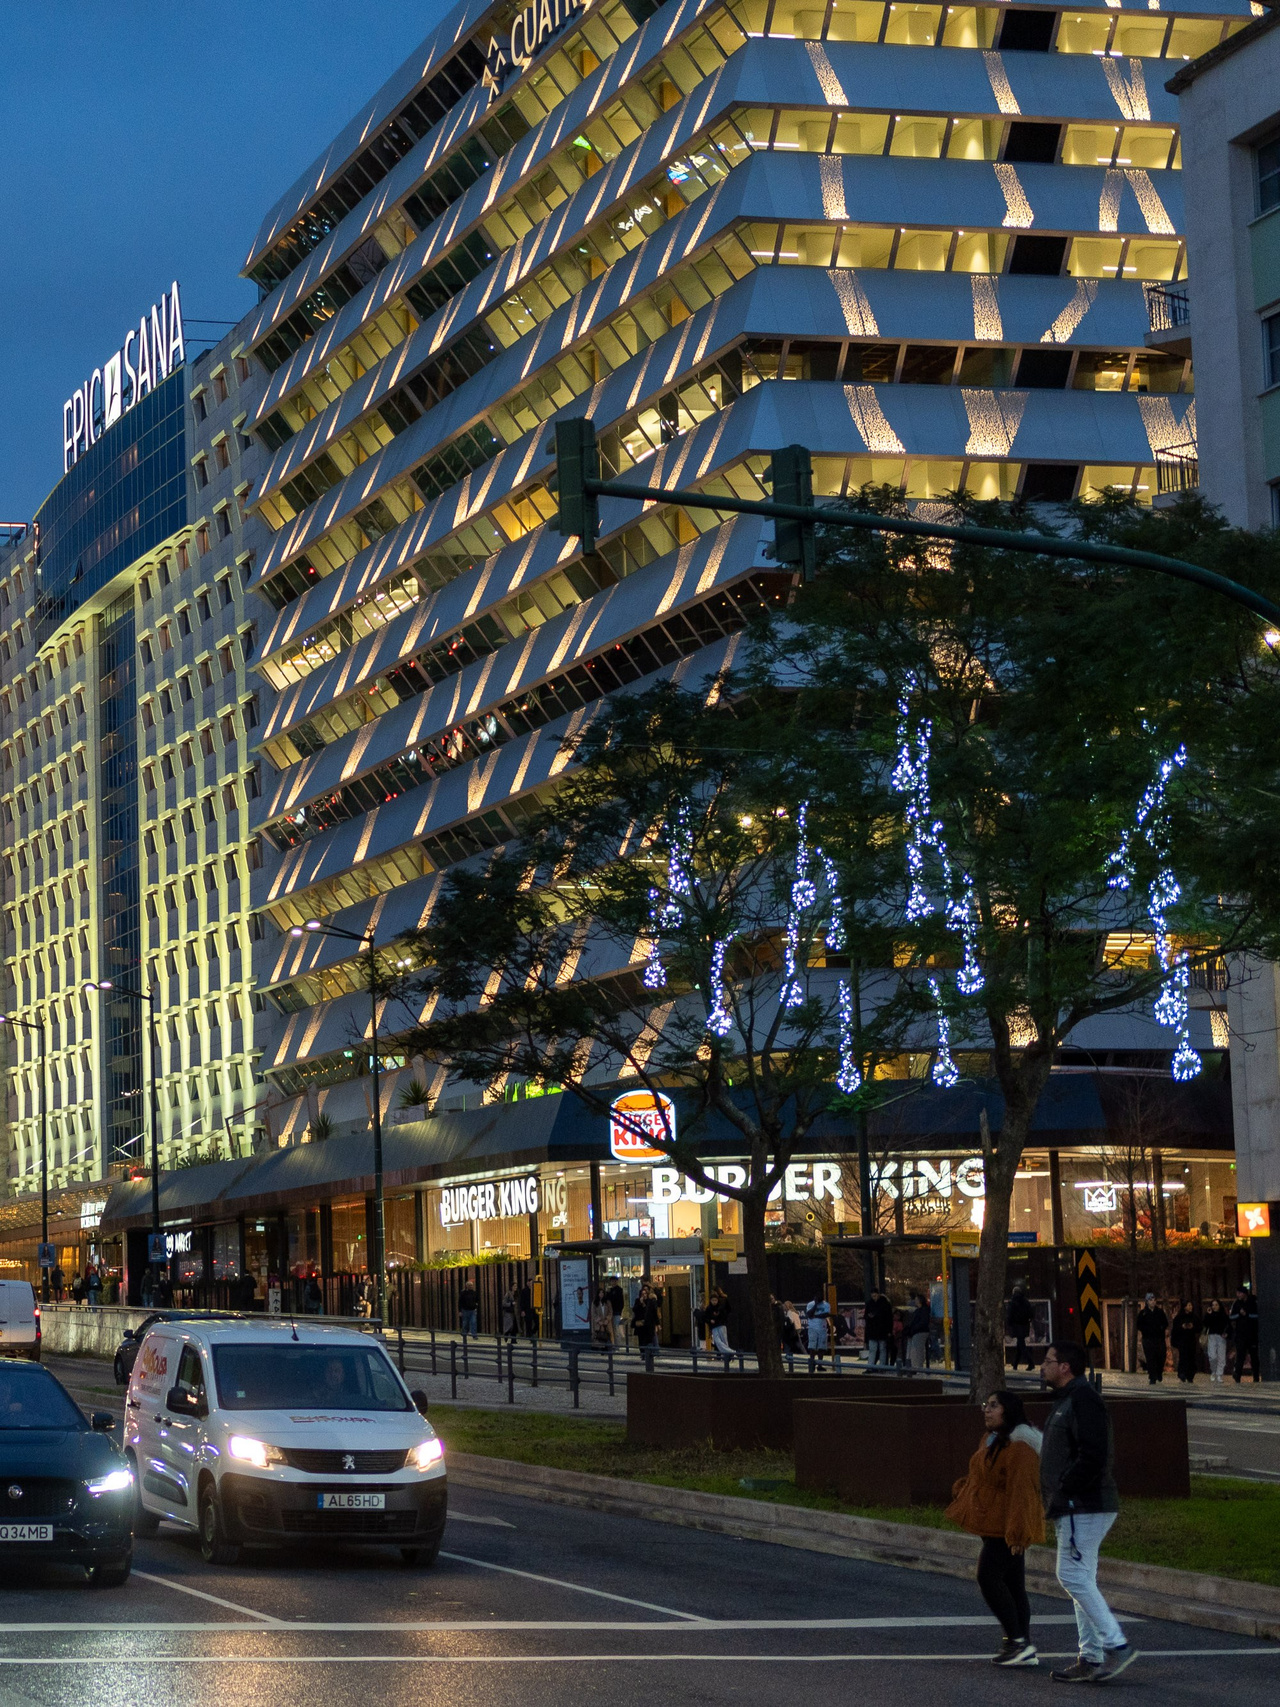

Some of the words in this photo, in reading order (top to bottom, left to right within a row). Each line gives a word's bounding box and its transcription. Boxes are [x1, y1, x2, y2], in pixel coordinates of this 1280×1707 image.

[64, 368, 102, 475] EPIC
[123, 280, 185, 413] SANA
[441, 1183, 497, 1223] BURGER
[500, 1176, 538, 1217] KING
[869, 1157, 986, 1200] KING
